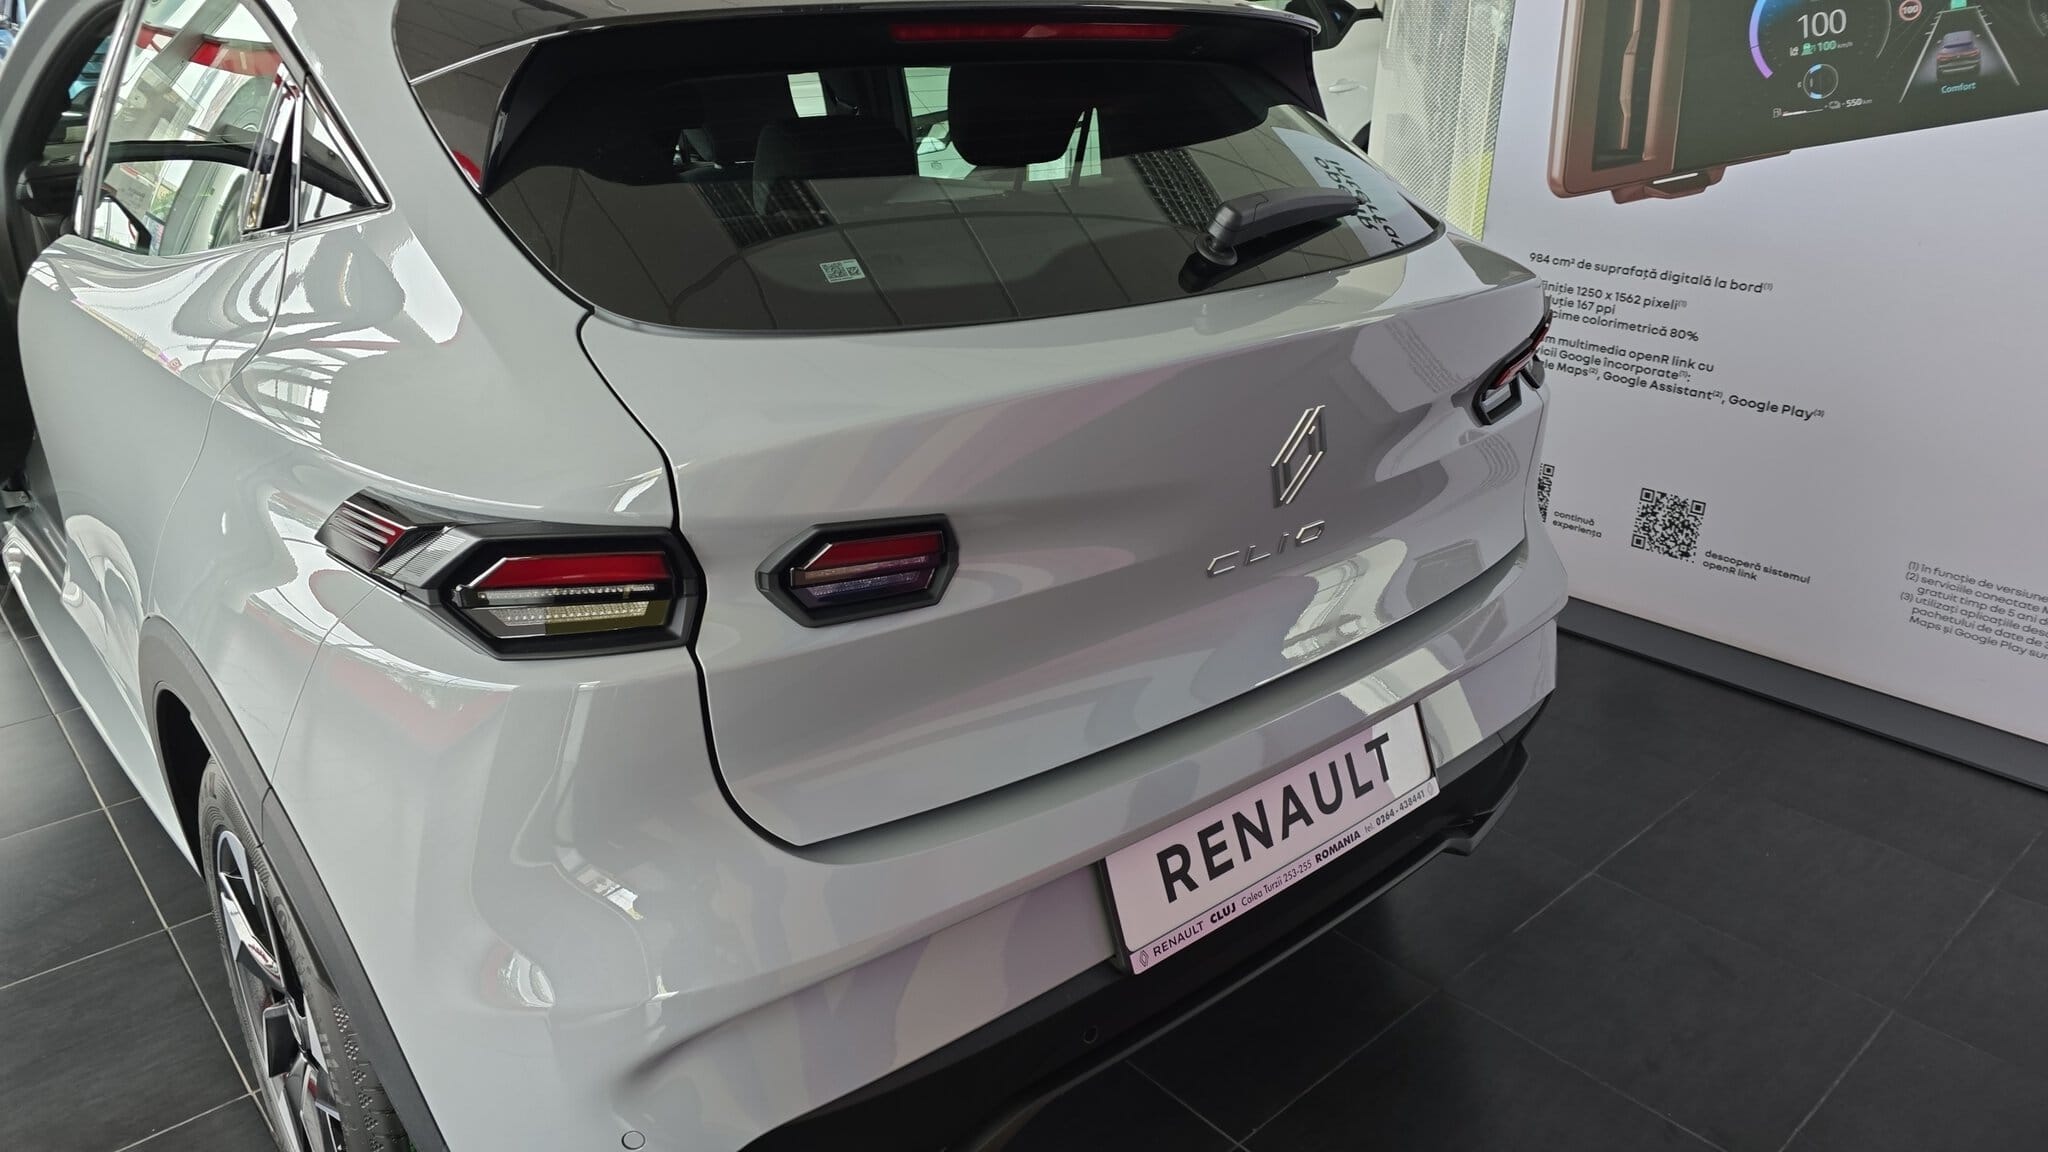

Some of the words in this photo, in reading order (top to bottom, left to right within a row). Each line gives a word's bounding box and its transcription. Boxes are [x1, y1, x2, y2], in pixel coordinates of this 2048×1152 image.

[1797, 9, 1847, 39] 100
[1817, 40, 1837, 52] 100
[1941, 82, 1977, 94] Comfort
[1529, 252, 1550, 265] 984
[1577, 259, 1592, 270] de
[1594, 264, 1657, 281] suprafață
[1660, 269, 1712, 286] digitală
[1714, 276, 1727, 289] la
[1577, 286, 1603, 299] 1250
[1604, 292, 1613, 300] x
[1615, 292, 1641, 305] 1562
[1577, 298, 1595, 311] 167
[1595, 304, 1616, 316] ppi
[1582, 315, 1667, 337] colorimetrică
[1669, 328, 1699, 342] 80%
[1558, 337, 1626, 357] multimedia
[1628, 350, 1670, 365] openR
[1671, 355, 1695, 370] link
[1697, 362, 1714, 372] cu
[1560, 349, 1602, 366] Google
[1603, 371, 1647, 388] Google
[1728, 394, 1779, 413] Google
[1553, 511, 1595, 526] continuă
[1207, 520, 1326, 578] CLIO
[1702, 560, 1736, 574] openR
[1737, 568, 1758, 580] link
[1704, 549, 1762, 571] descoperă
[1762, 565, 1811, 584] sistemul
[1900, 592, 1914, 603] (3)
[1905, 571, 1919, 583] (2)
[1920, 576, 1973, 595] serviciile
[1974, 590, 2040, 612] conectate
[1978, 578, 1993, 589] de
[1917, 587, 1958, 603] gratuit
[1960, 597, 1988, 610] timp
[1990, 604, 2006, 615] de
[2007, 608, 2017, 617] 5
[2017, 612, 2037, 623] ani
[1909, 615, 1942, 631] Maps
[1954, 628, 1998, 646] Google
[2000, 640, 2027, 655] Play
[1911, 607, 1976, 629] pachetului
[1976, 623, 1993, 634] de
[1994, 628, 2024, 641] date
[2025, 636, 2042, 647] de
[1156, 732, 1390, 904] RENAULT
[1153, 921, 1204, 957] RENAULT
[1210, 902, 1236, 924] CLUJ
[1241, 891, 1263, 906] Calea
[1263, 876, 1283, 894] Turzii
[1283, 861, 1312, 883] 253-255
[1315, 830, 1361, 863] ROMANIA
